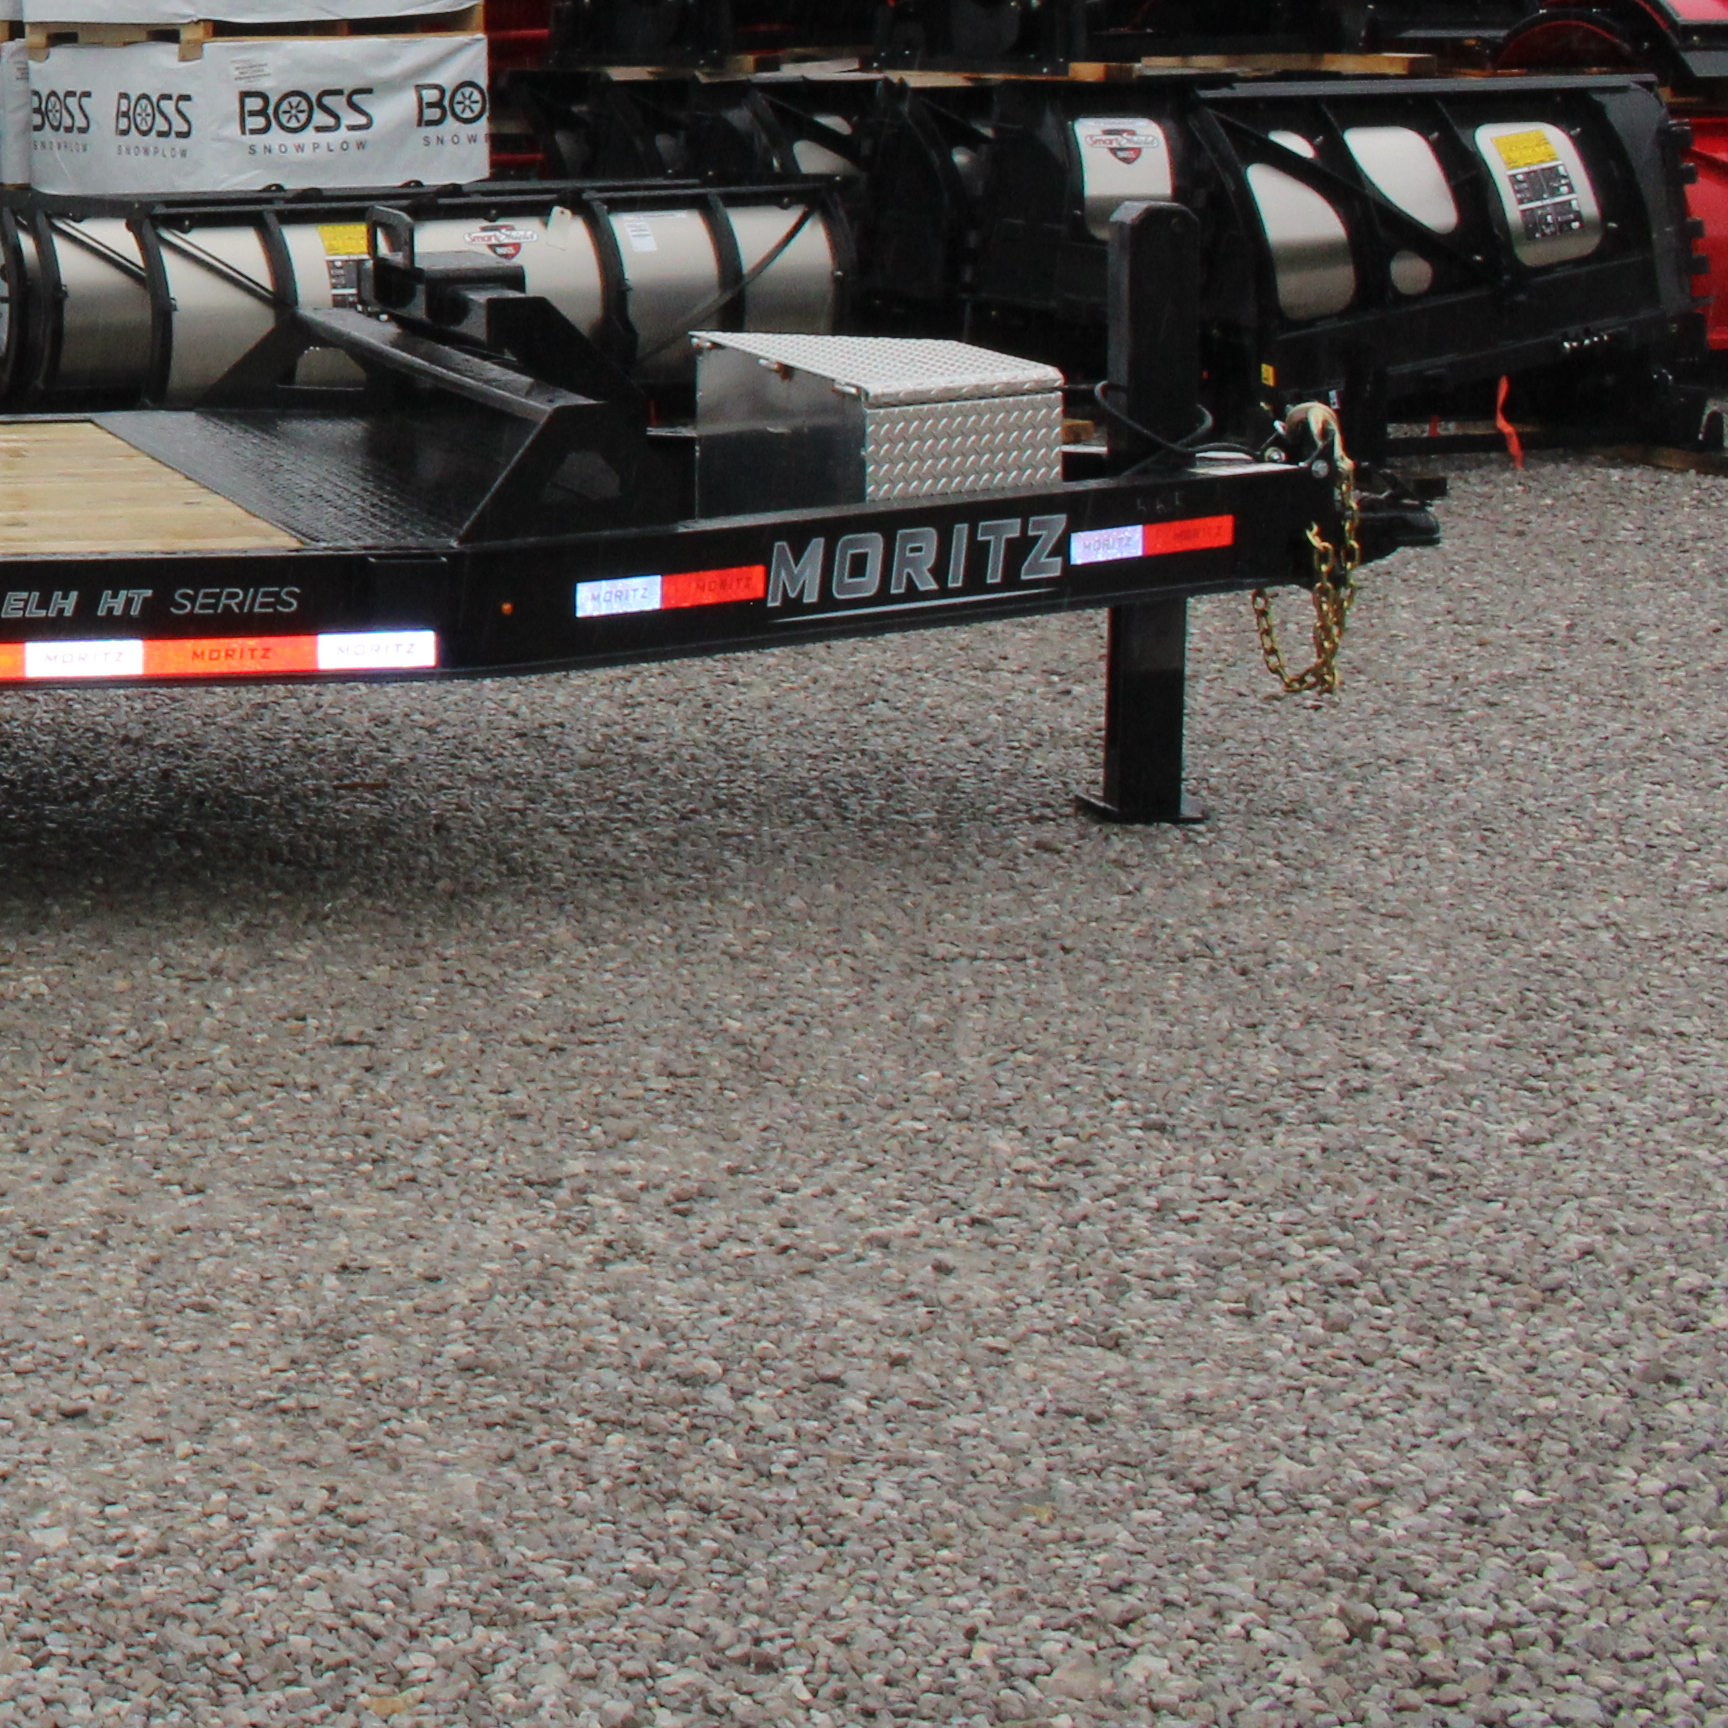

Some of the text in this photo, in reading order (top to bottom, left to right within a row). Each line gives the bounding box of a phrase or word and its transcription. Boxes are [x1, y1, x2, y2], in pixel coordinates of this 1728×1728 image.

[31, 90, 91, 134] BOSS
[116, 92, 192, 138] BOSS
[239, 88, 374, 136] BOSS
[415, 81, 487, 127] BO
[117, 145, 187, 158] SNOWPLOW
[248, 140, 368, 155] SNOWPLOW
[1082, 535, 1135, 552] MORITZ
[768, 515, 1067, 607] MORITZ
[1, 587, 301, 618] ELH HT SERIES
[590, 585, 650, 605] MORITZ
[192, 648, 271, 661] MORITZ
[336, 643, 416, 656] MORITZ
